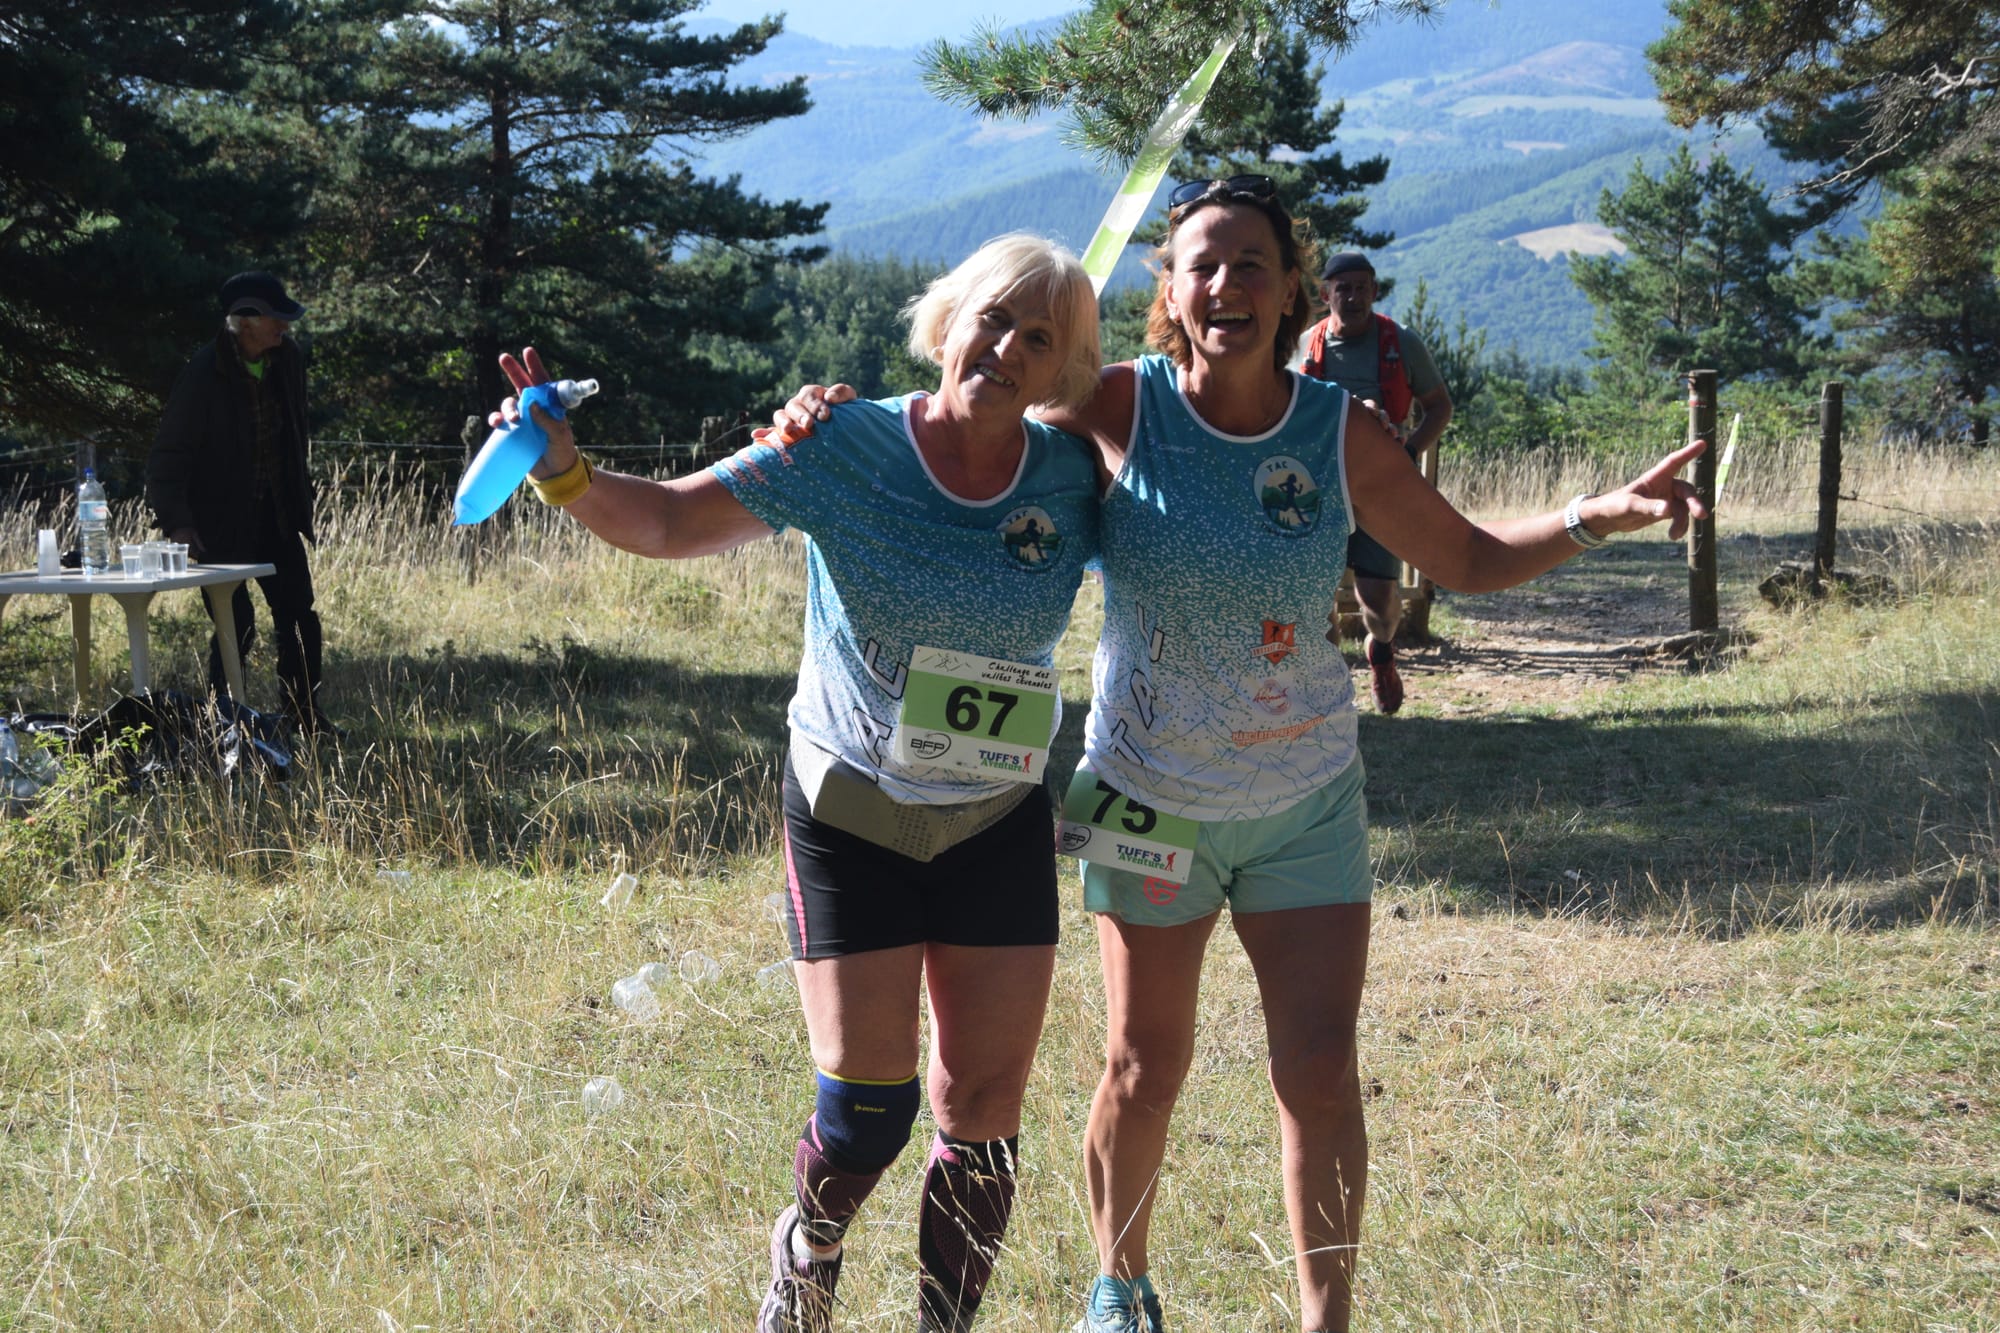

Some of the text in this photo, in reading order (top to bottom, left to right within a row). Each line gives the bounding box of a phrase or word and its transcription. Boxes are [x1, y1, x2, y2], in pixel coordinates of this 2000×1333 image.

[1266, 461, 1288, 473] TAC
[988, 661, 1051, 680] Challenge des
[945, 685, 1019, 737] 67
[910, 737, 946, 752] BFP
[978, 749, 1021, 766] TUFF'S
[1091, 779, 1158, 834] 75
[1116, 843, 1162, 863] TUFF'S
